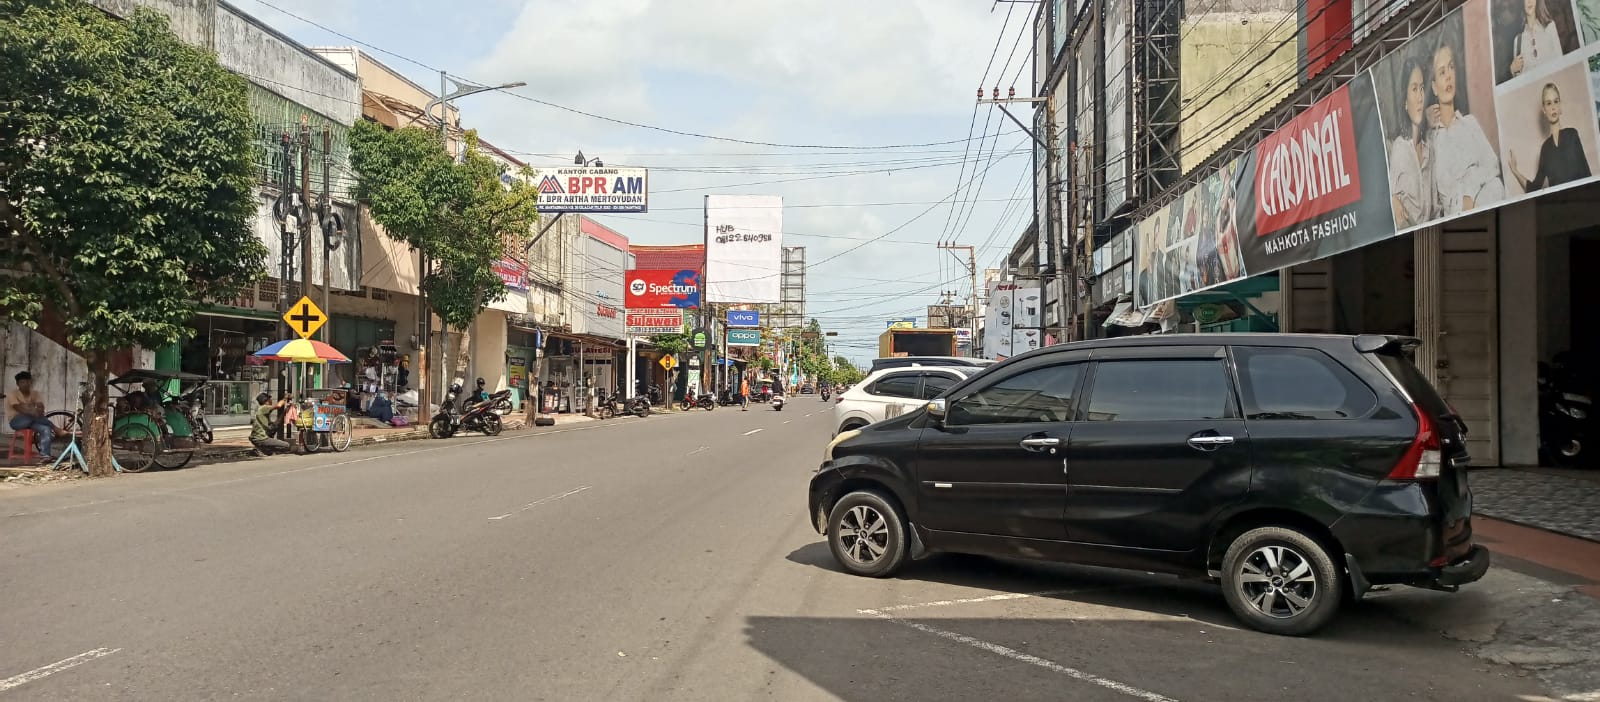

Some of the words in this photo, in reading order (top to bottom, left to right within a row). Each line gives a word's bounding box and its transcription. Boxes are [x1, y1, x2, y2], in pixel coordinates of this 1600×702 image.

[568, 176, 608, 194] BPR
[612, 176, 643, 194] AM
[546, 195, 562, 203] BPR
[564, 195, 589, 203] ARTHA
[591, 195, 642, 203] MERTOYUDAN
[715, 224, 735, 233] HUB
[1264, 231, 1310, 255] MAHKOTA
[1311, 211, 1358, 241] FASHION
[649, 282, 697, 296] Spectrum
[626, 315, 682, 327] Sulawesi
[732, 332, 756, 340] oppo
